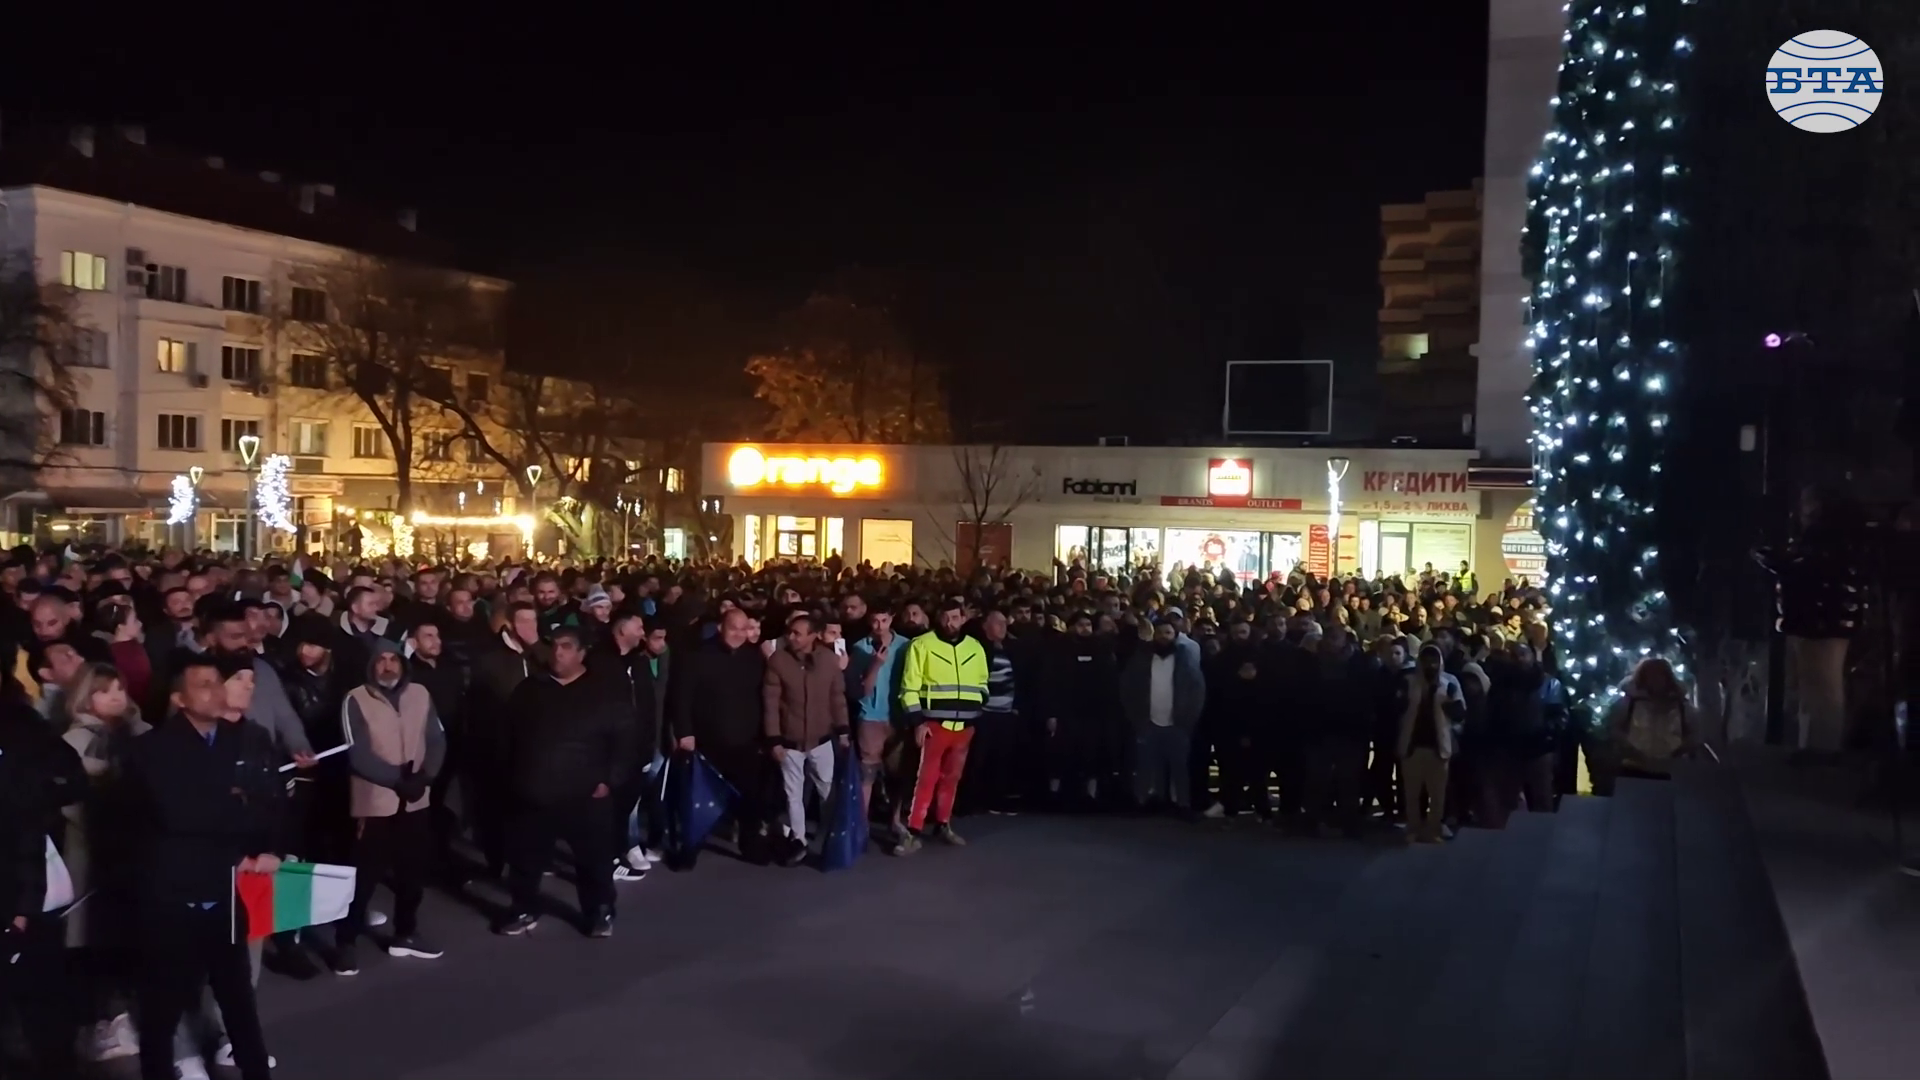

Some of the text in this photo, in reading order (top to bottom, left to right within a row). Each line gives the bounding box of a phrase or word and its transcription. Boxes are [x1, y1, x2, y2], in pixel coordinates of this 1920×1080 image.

[1363, 471, 1467, 496] КРЕДИТИ
[1178, 498, 1283, 508] BRANDS OUTLET
[1374, 500, 1391, 511] 1,5
[1403, 501, 1411, 511] 2
[1426, 501, 1469, 512] ЛИХВА
